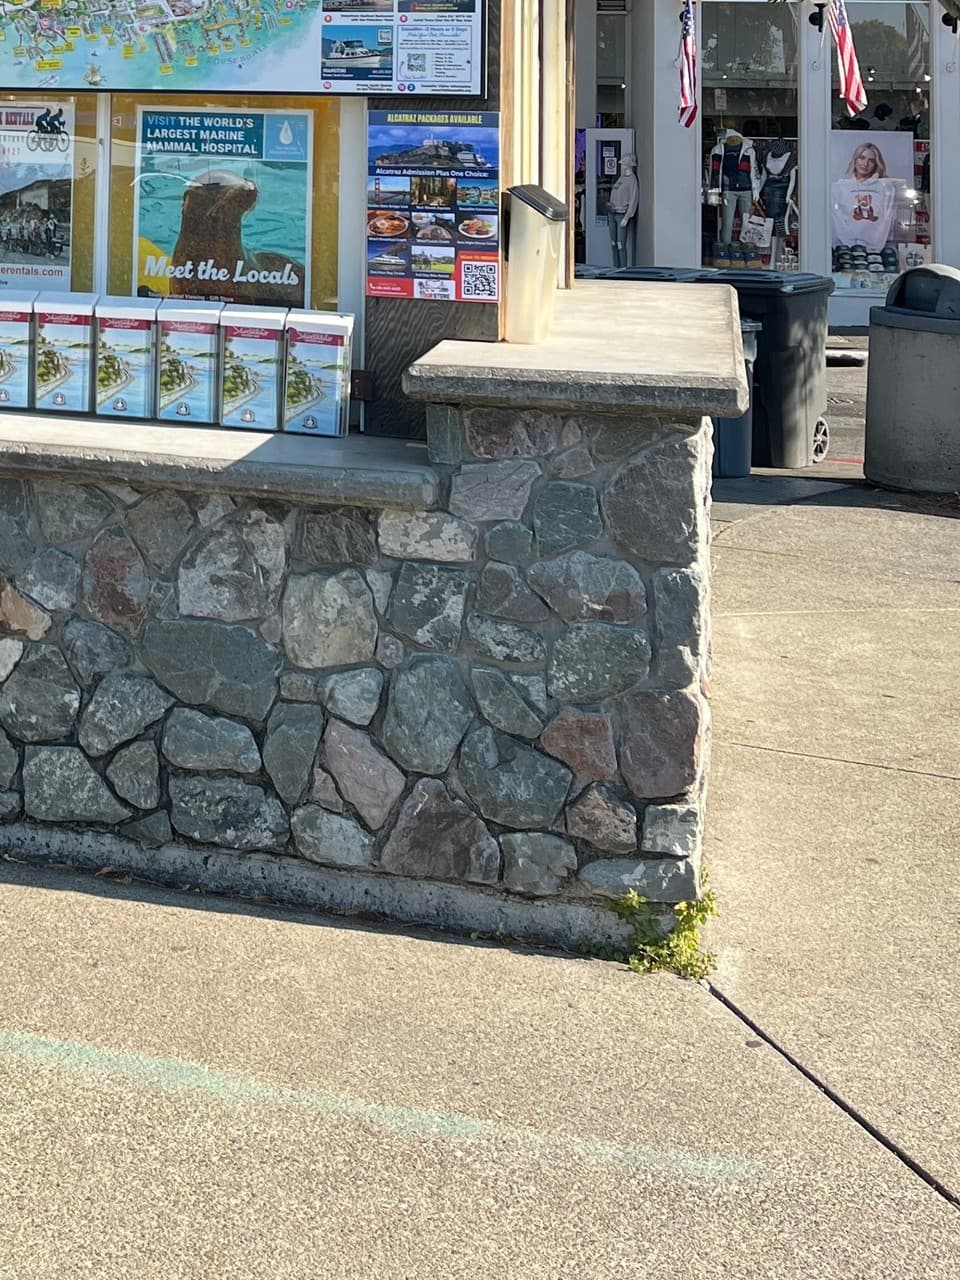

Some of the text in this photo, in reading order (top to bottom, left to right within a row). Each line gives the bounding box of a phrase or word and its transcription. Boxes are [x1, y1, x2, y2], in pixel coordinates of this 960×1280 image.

[5, 112, 34, 126] RENTALS
[147, 116, 254, 128] VISIT THE WORLD'S
[387, 114, 482, 124] ALCATRAZ PACKAGES AVAILABLE
[147, 129, 244, 141] LARGEST MARINE
[146, 142, 258, 154] MAMMAL HOSPITAL
[144, 256, 300, 286] Meet the Locals
